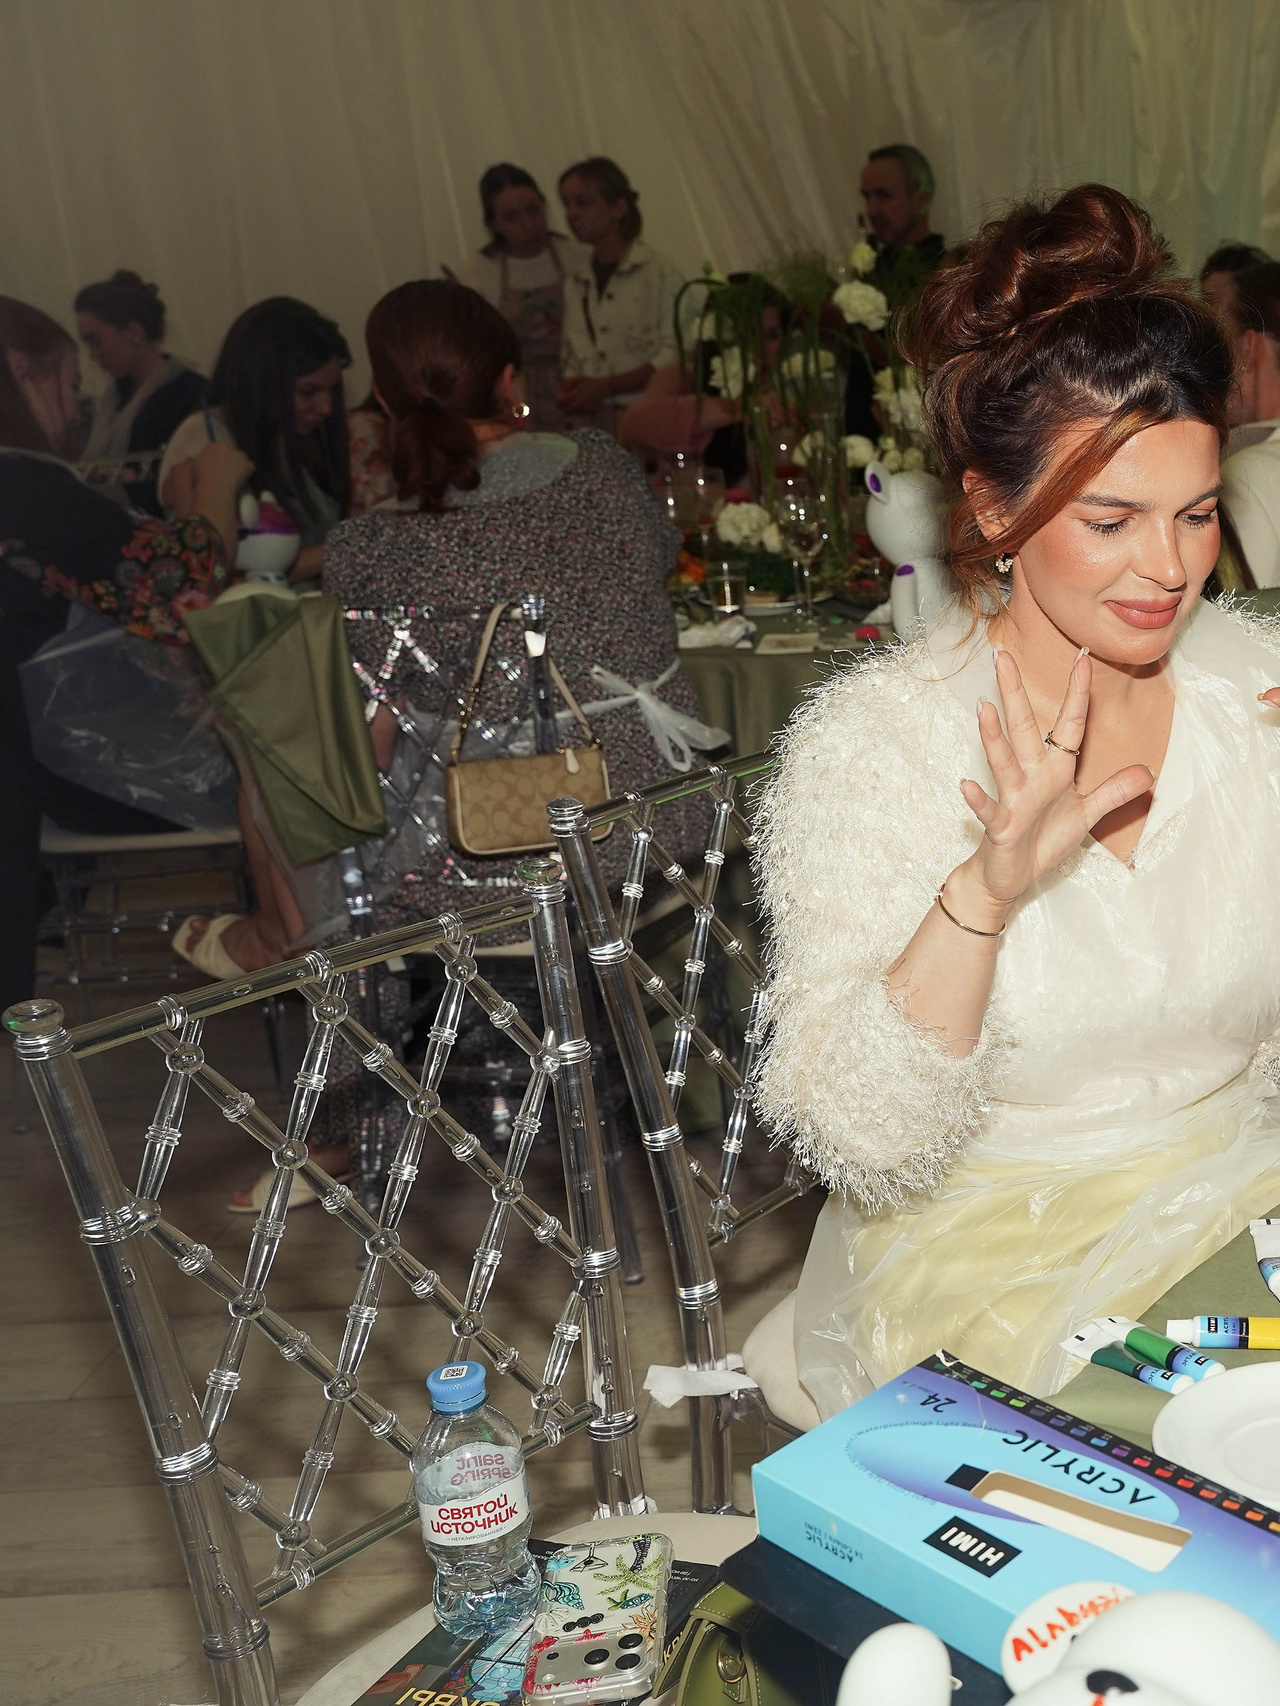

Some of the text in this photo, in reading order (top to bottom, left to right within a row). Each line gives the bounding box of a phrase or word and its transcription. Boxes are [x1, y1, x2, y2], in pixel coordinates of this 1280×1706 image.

[920, 1393, 957, 1413] 24
[1002, 1429, 1156, 1505] ACRYLIC
[430, 1502, 519, 1535] ИСТОЧНИК
[437, 1493, 509, 1521] СВЯТОЙ
[805, 1530, 853, 1563] ACRYLIC
[939, 1526, 1005, 1567] HIMI
